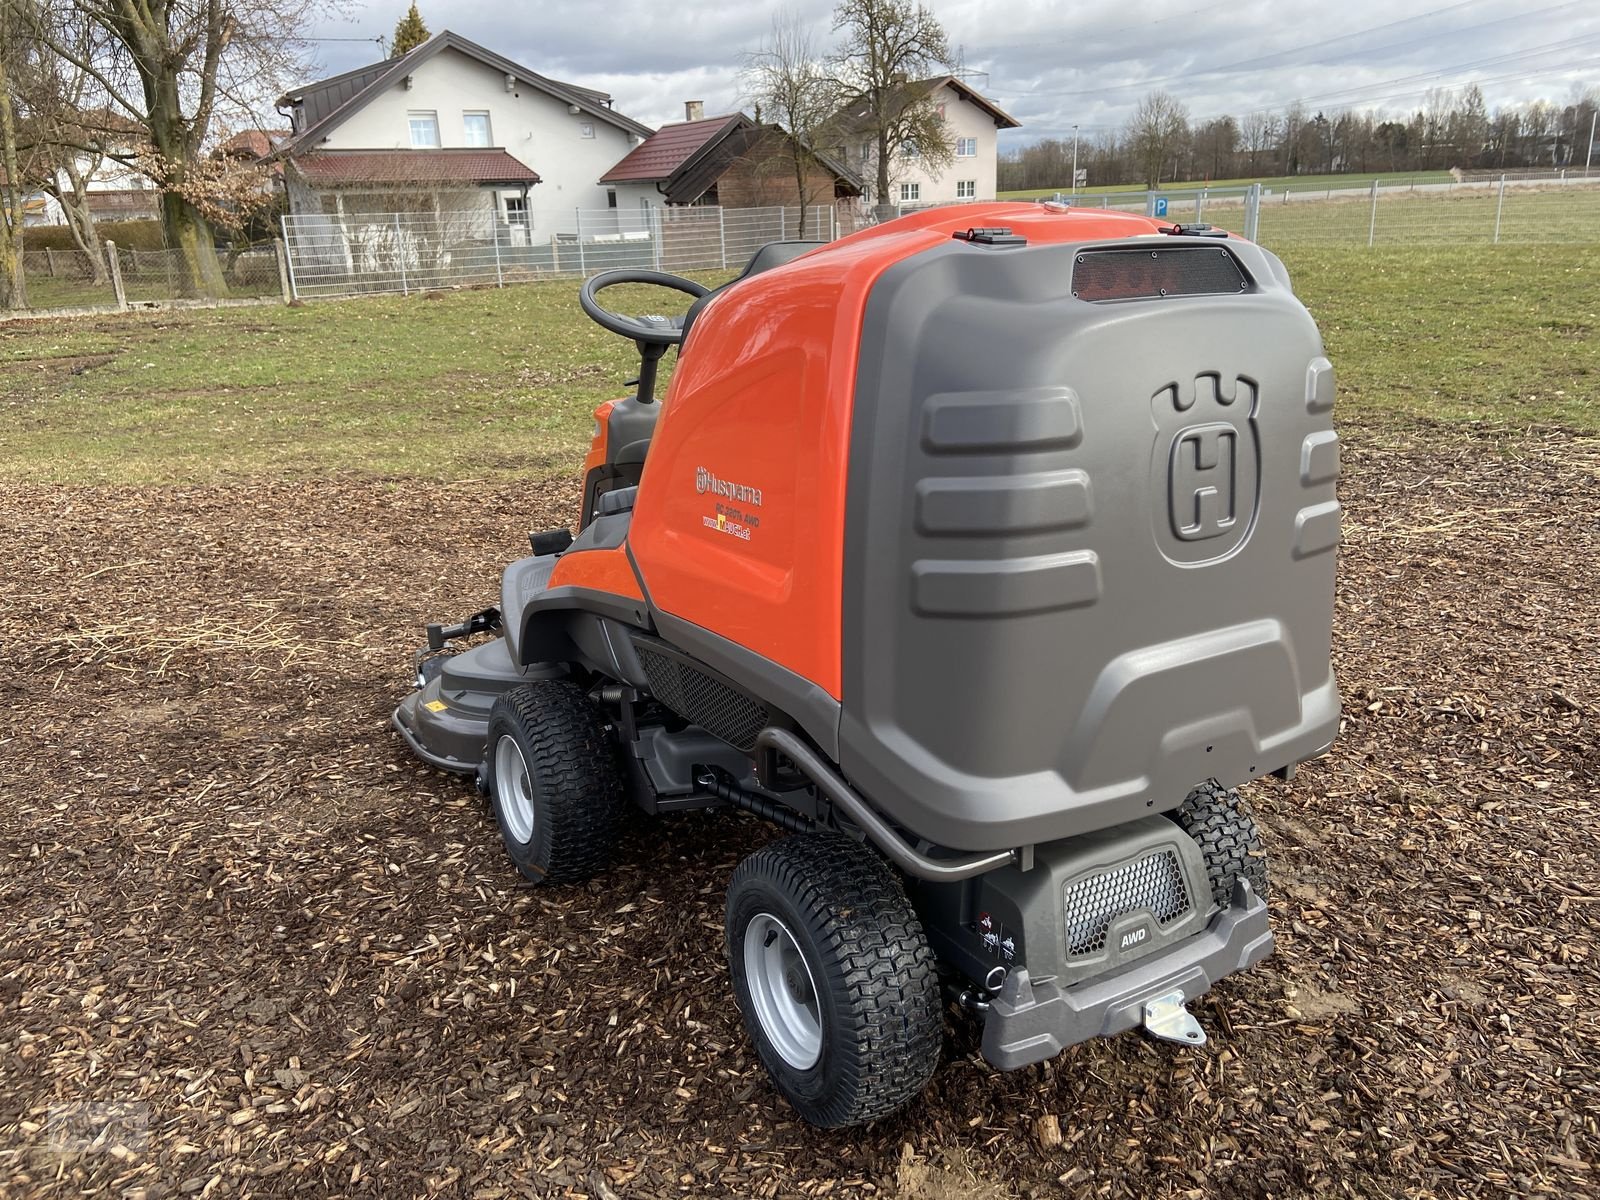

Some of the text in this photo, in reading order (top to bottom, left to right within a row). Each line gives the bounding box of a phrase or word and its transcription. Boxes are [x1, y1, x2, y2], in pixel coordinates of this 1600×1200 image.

[1157, 199, 1166, 215] P
[706, 472, 762, 506] Husqvarna
[744, 513, 759, 528] AWD
[1121, 928, 1146, 948] AWD
